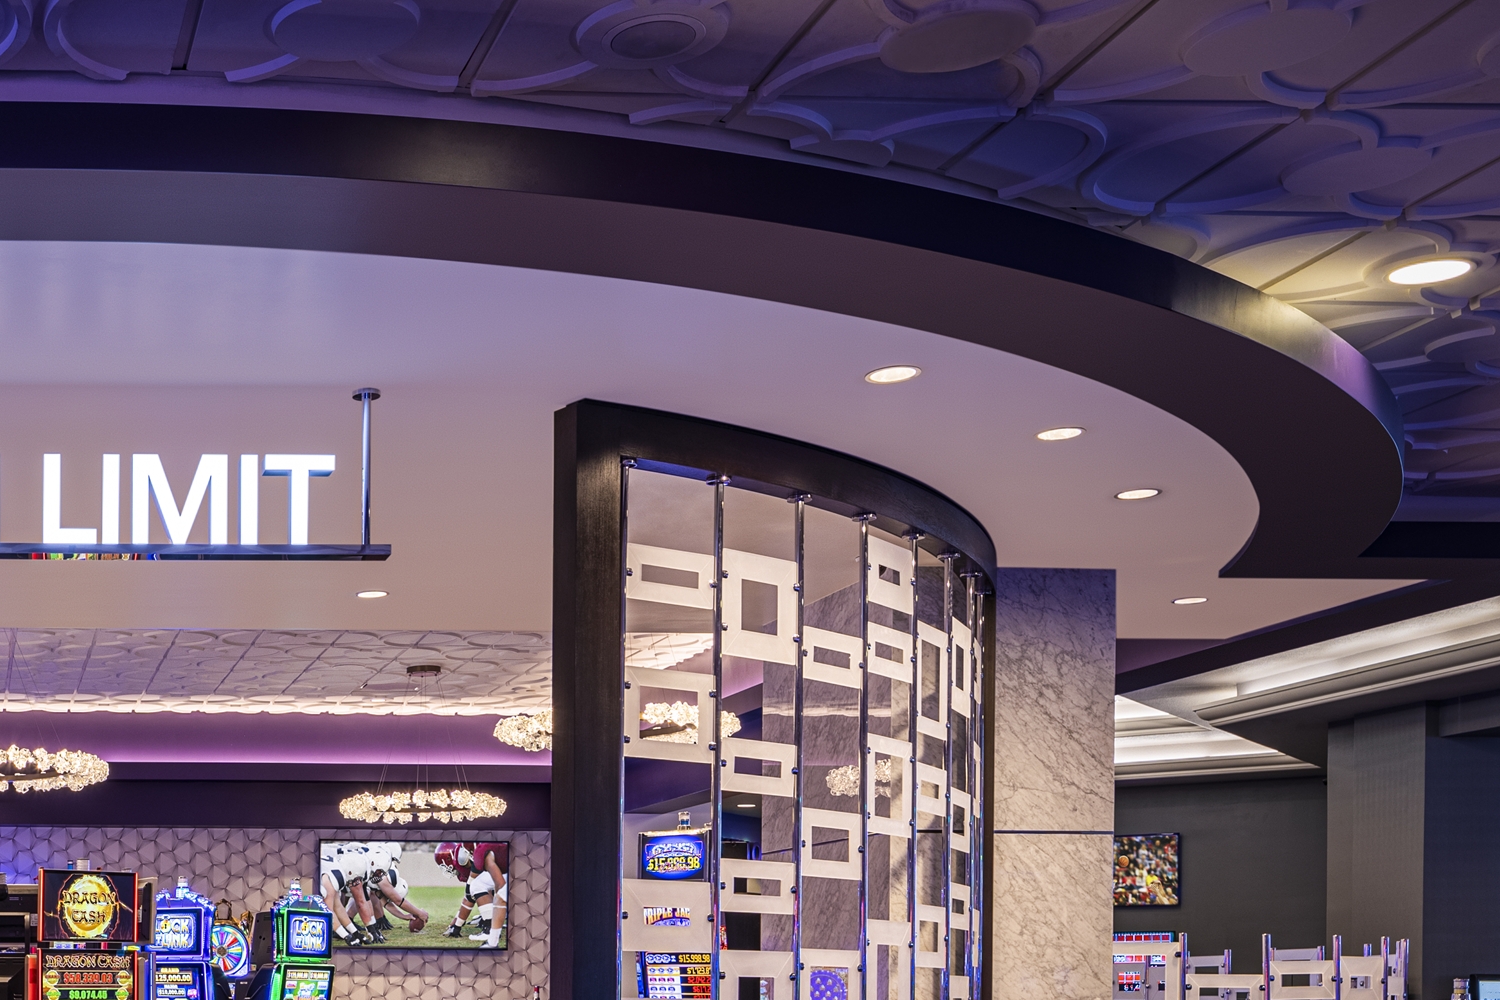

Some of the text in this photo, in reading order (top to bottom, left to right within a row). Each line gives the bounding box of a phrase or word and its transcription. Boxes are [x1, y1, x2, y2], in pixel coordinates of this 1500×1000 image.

[42, 453, 336, 546] LIMIT
[62, 890, 117, 904] DRAGON
[72, 910, 106, 923] CASH
[296, 920, 323, 937] LOCK
[303, 935, 323, 950] LINK
[45, 955, 131, 968] DRAGON CASH
